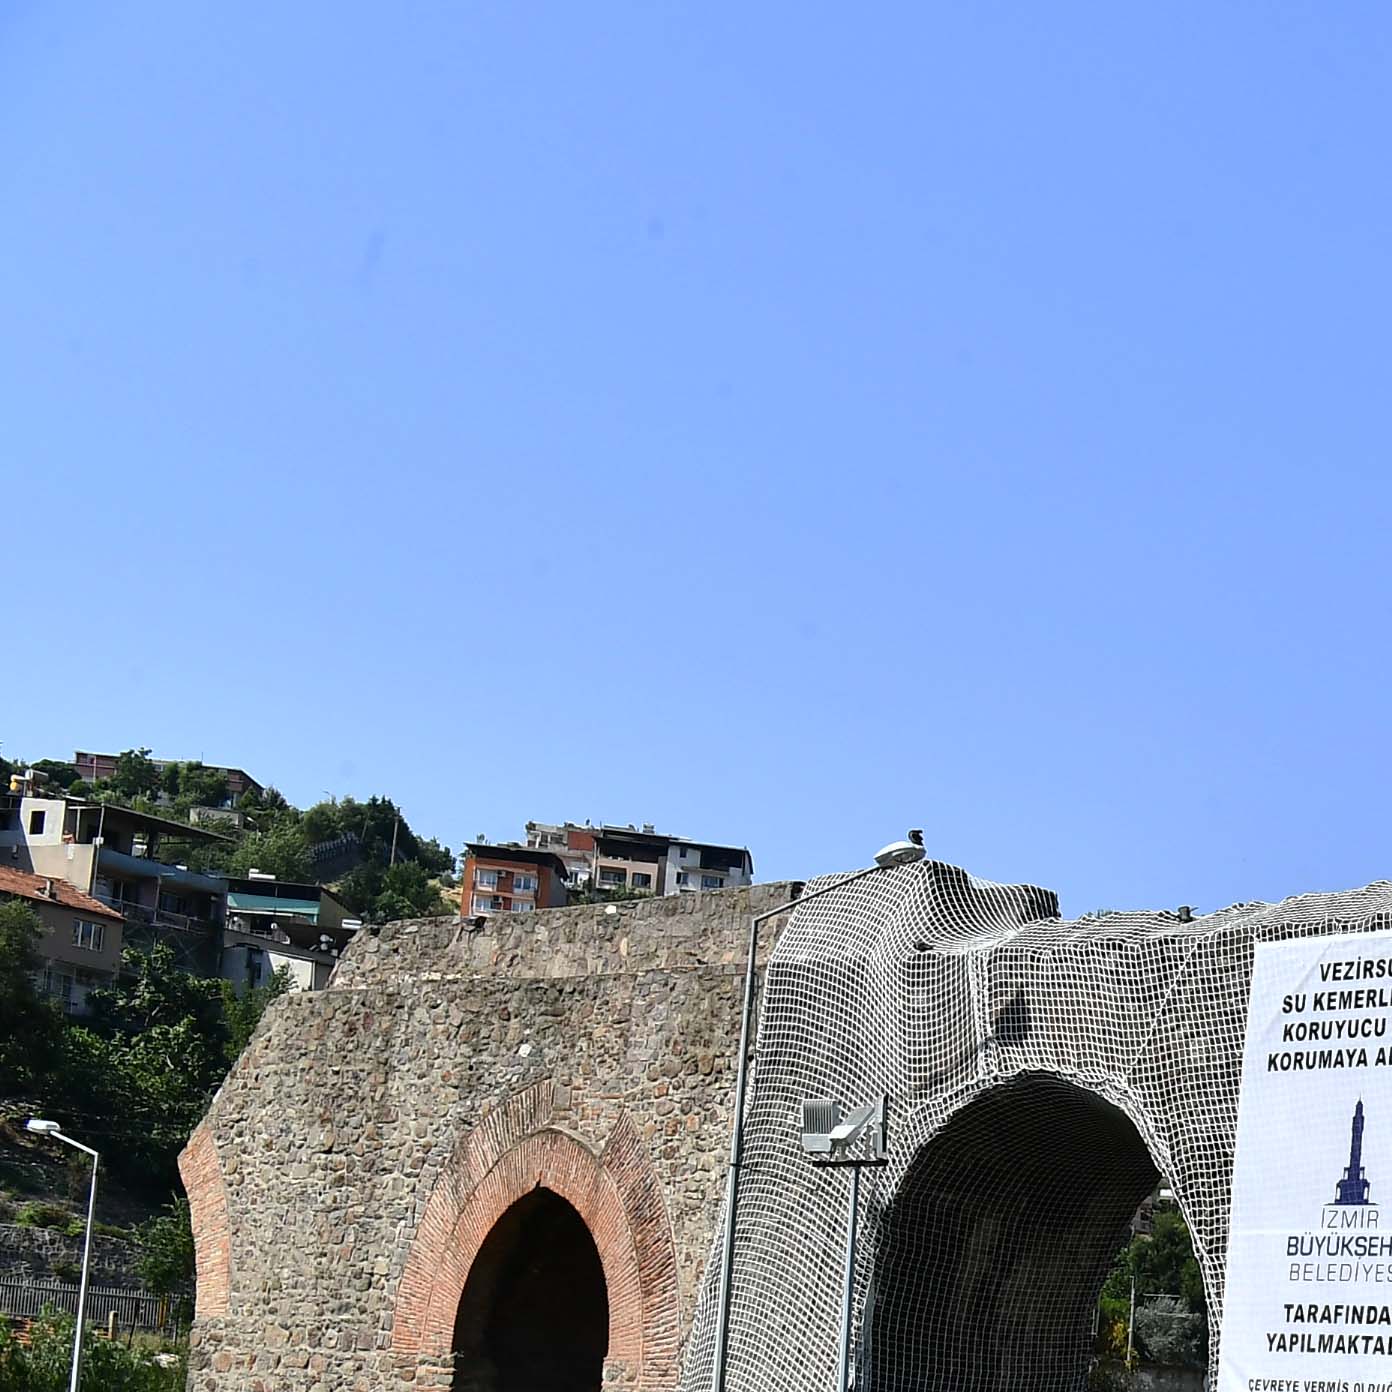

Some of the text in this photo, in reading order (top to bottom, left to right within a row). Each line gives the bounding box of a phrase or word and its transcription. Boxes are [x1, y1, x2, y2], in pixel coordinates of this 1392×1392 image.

[1282, 993, 1307, 1014] SU
[1282, 1017, 1387, 1042] KORUYUCU
[1266, 1048, 1368, 1072] KORUMAYA
[1321, 1207, 1380, 1229] İZMİR
